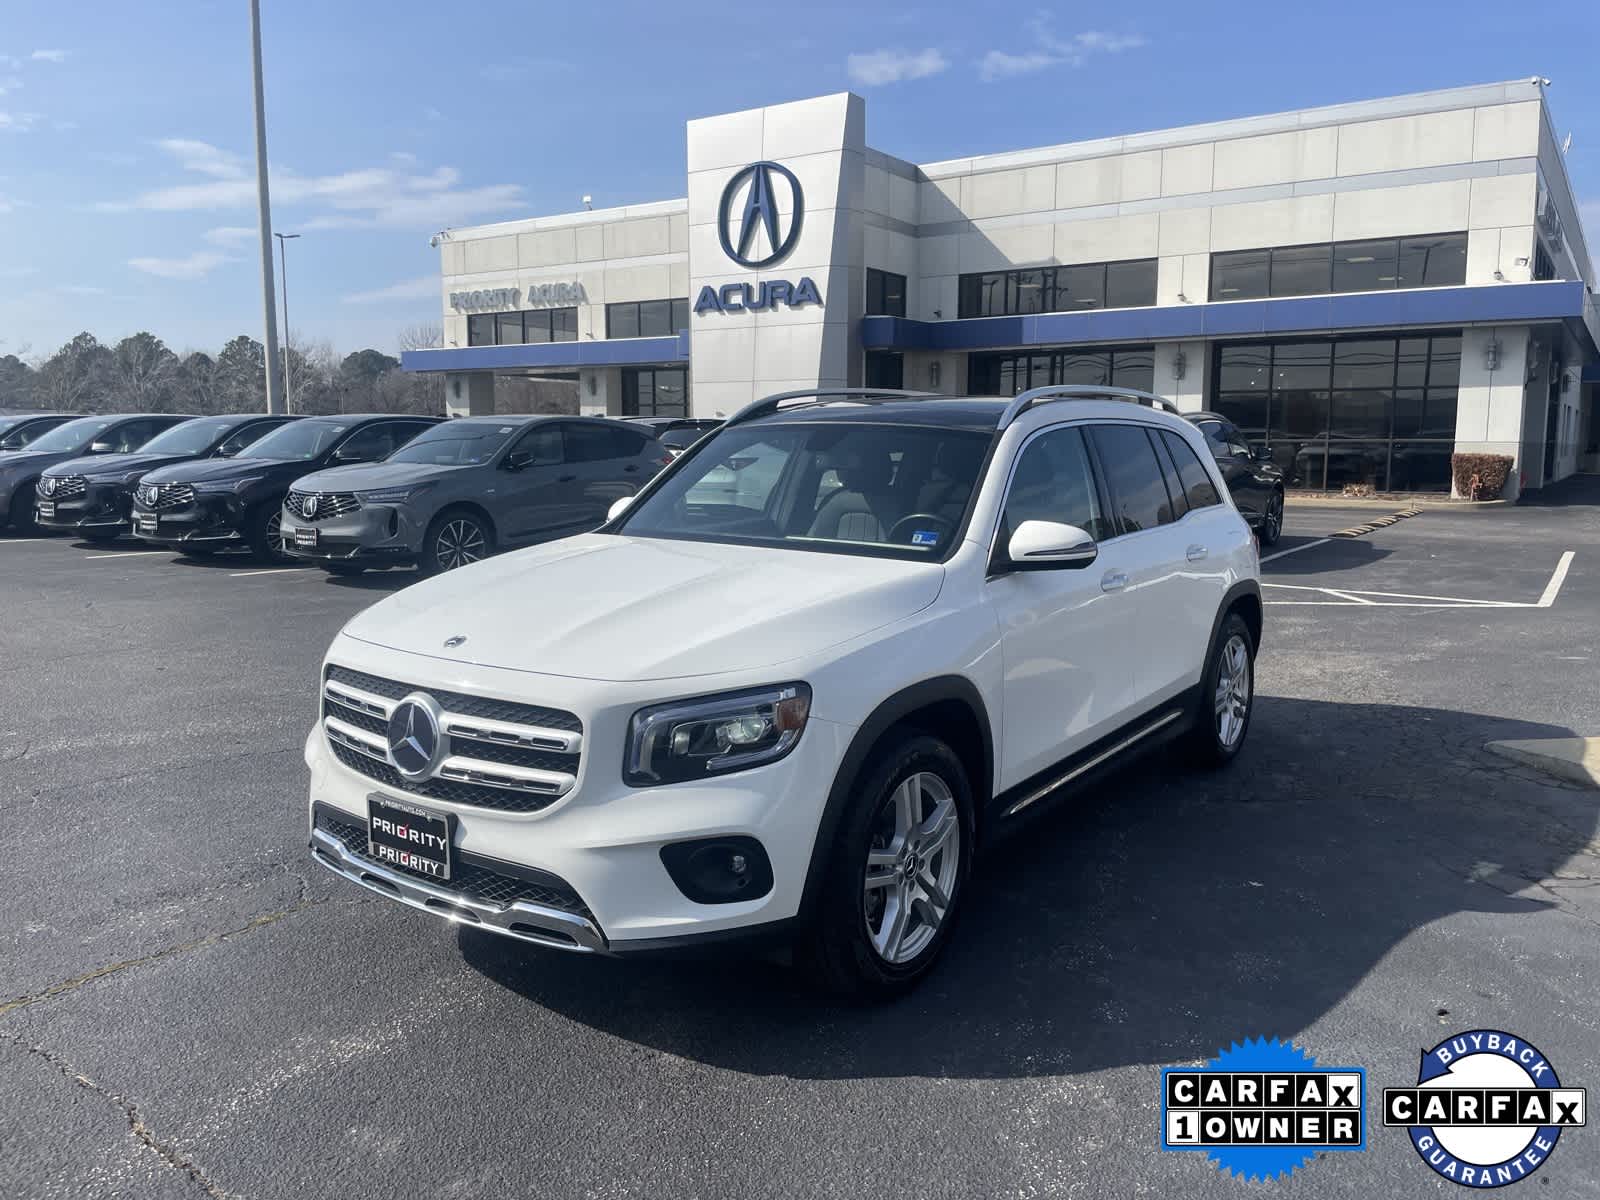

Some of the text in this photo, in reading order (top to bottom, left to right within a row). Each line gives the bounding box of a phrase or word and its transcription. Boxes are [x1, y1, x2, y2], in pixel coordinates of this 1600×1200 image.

[449, 280, 587, 310] PRIORITY ACURA
[693, 277, 823, 313] ACURA
[372, 816, 446, 851] PRIORITY
[379, 845, 438, 875] PRIORITY
